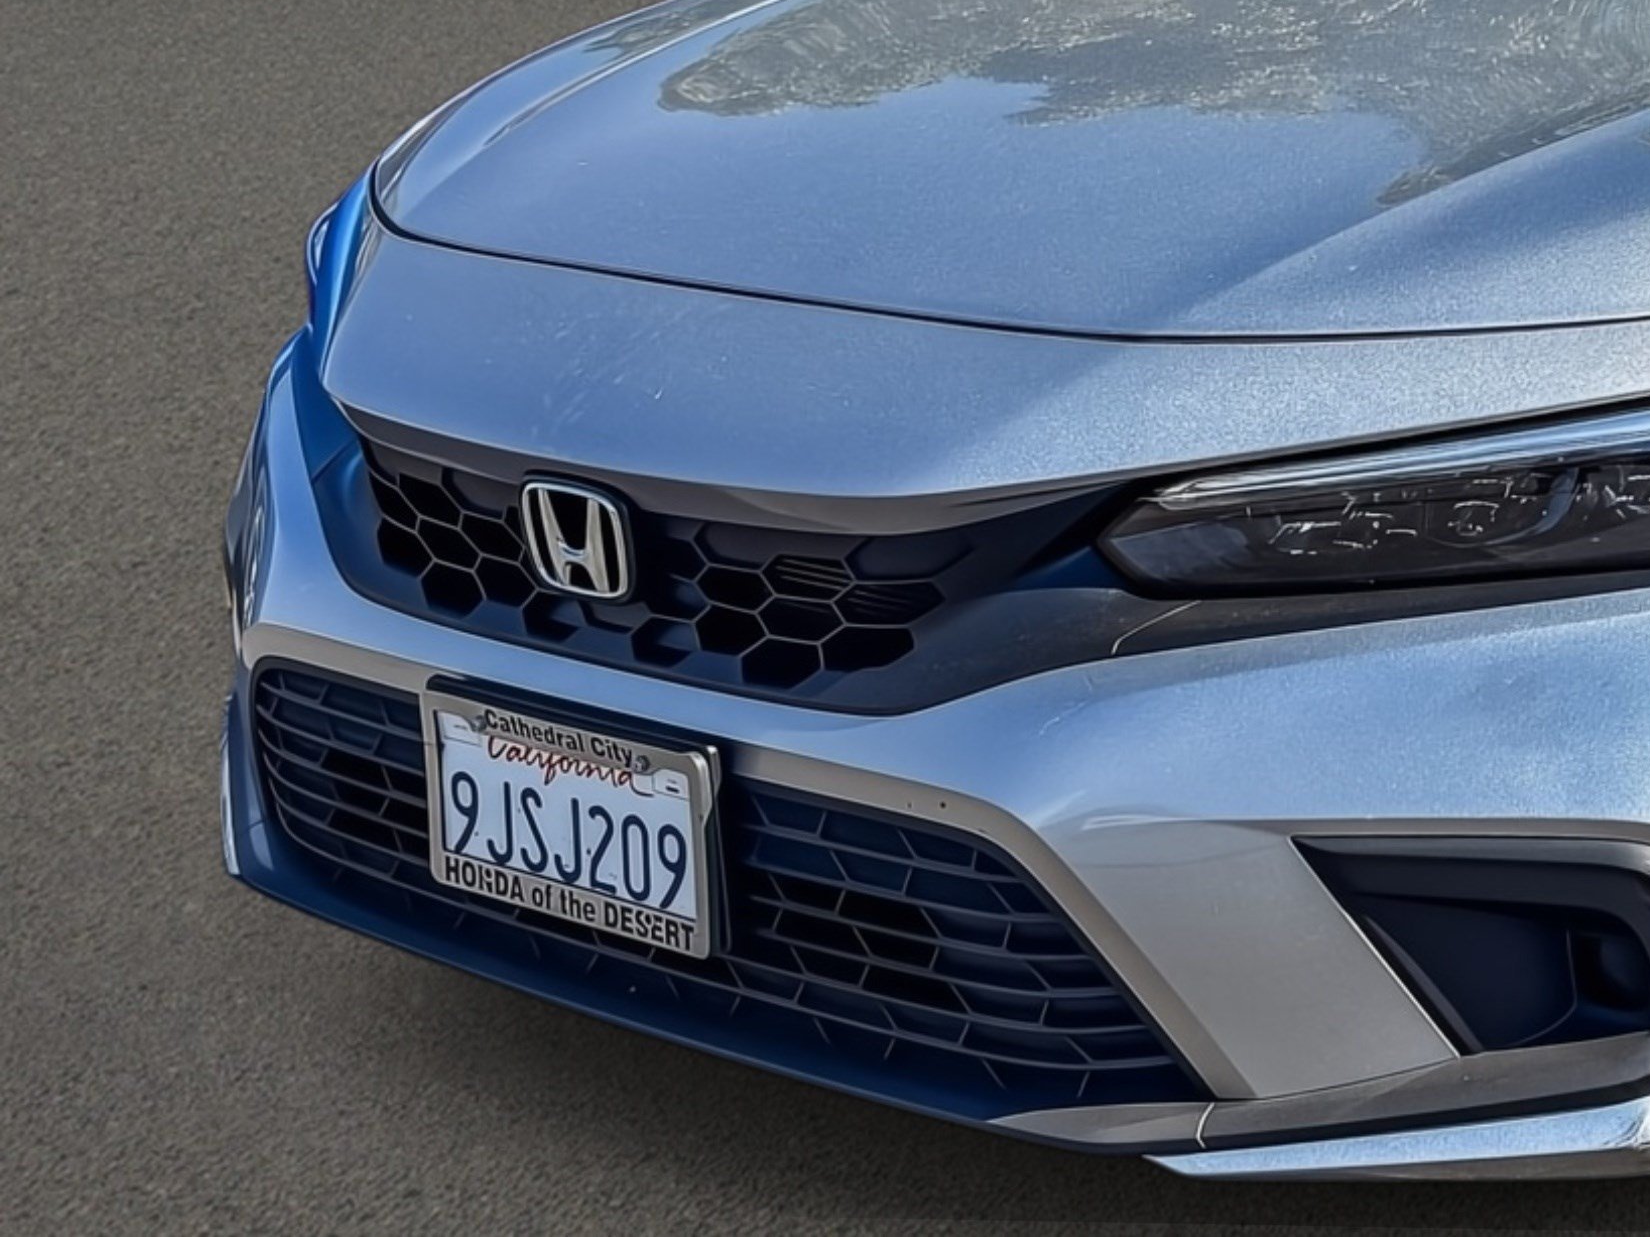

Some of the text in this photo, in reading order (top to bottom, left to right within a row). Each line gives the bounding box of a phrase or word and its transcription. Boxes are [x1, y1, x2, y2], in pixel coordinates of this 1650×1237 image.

[484, 709, 634, 768] Cathedral City
[487, 735, 654, 797] California
[451, 771, 687, 910] 9JSJ209
[445, 855, 696, 952] HONDA of the DESERT
